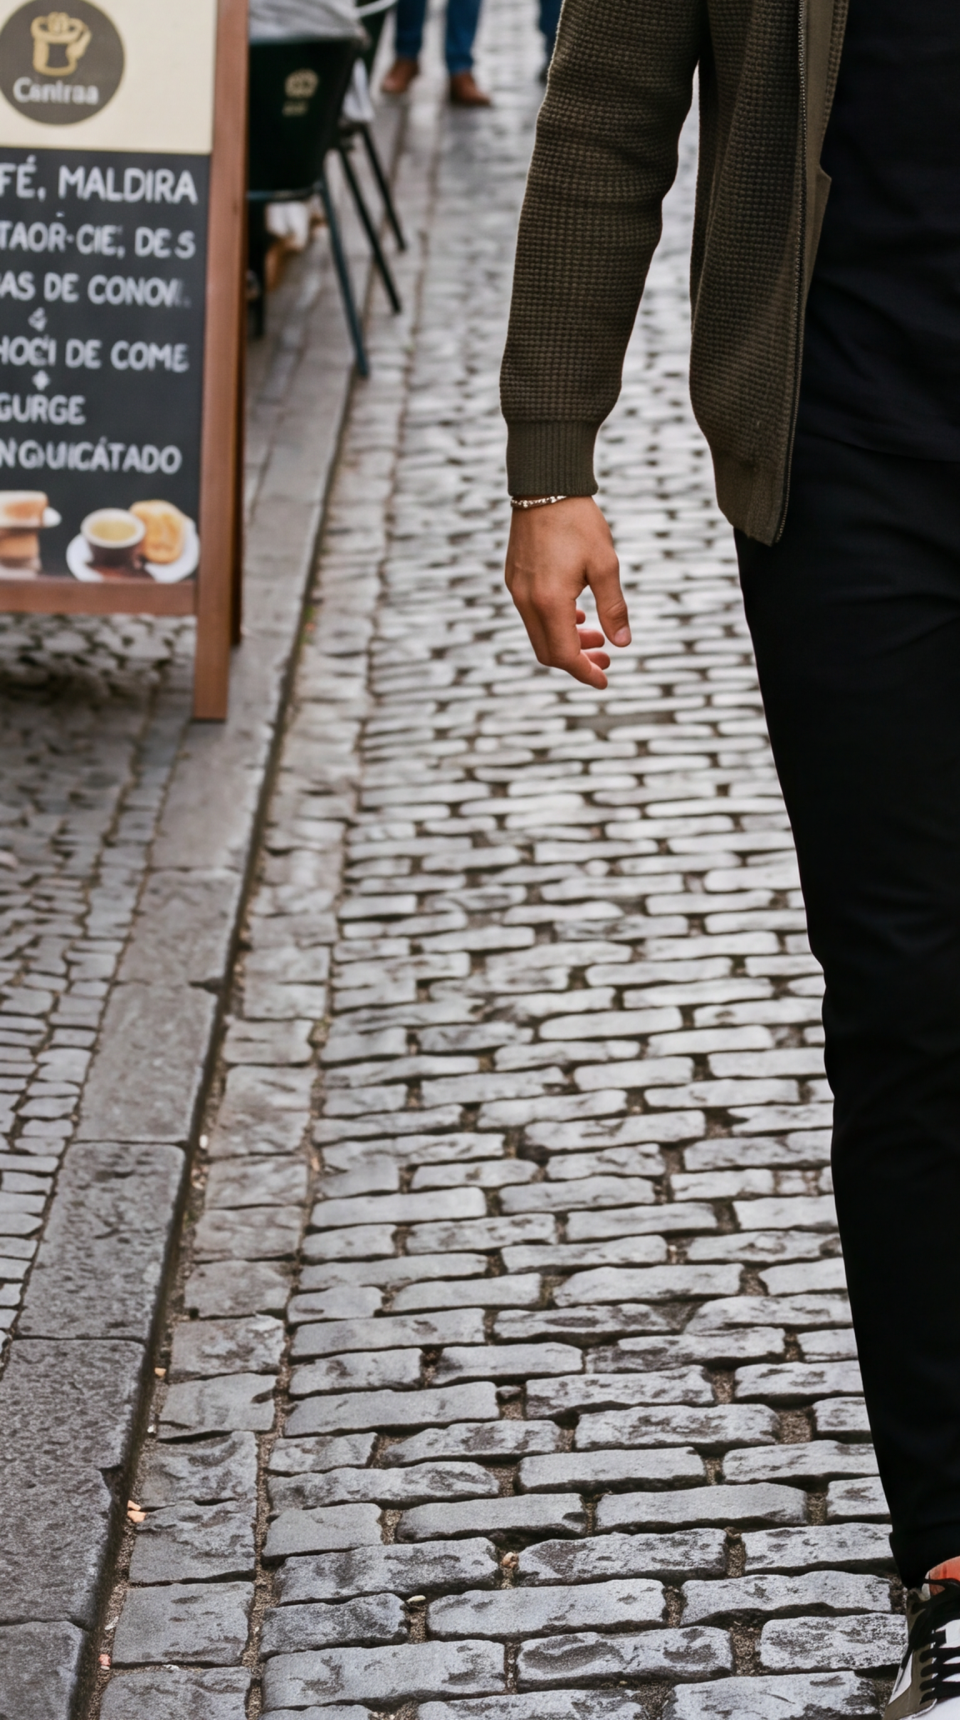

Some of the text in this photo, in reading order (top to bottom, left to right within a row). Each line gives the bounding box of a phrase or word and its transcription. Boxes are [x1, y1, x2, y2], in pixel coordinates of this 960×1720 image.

[58, 164, 198, 205] MALDIRA
[44, 272, 79, 303] DE
[65, 338, 102, 369] DE
[110, 340, 190, 373] COME
